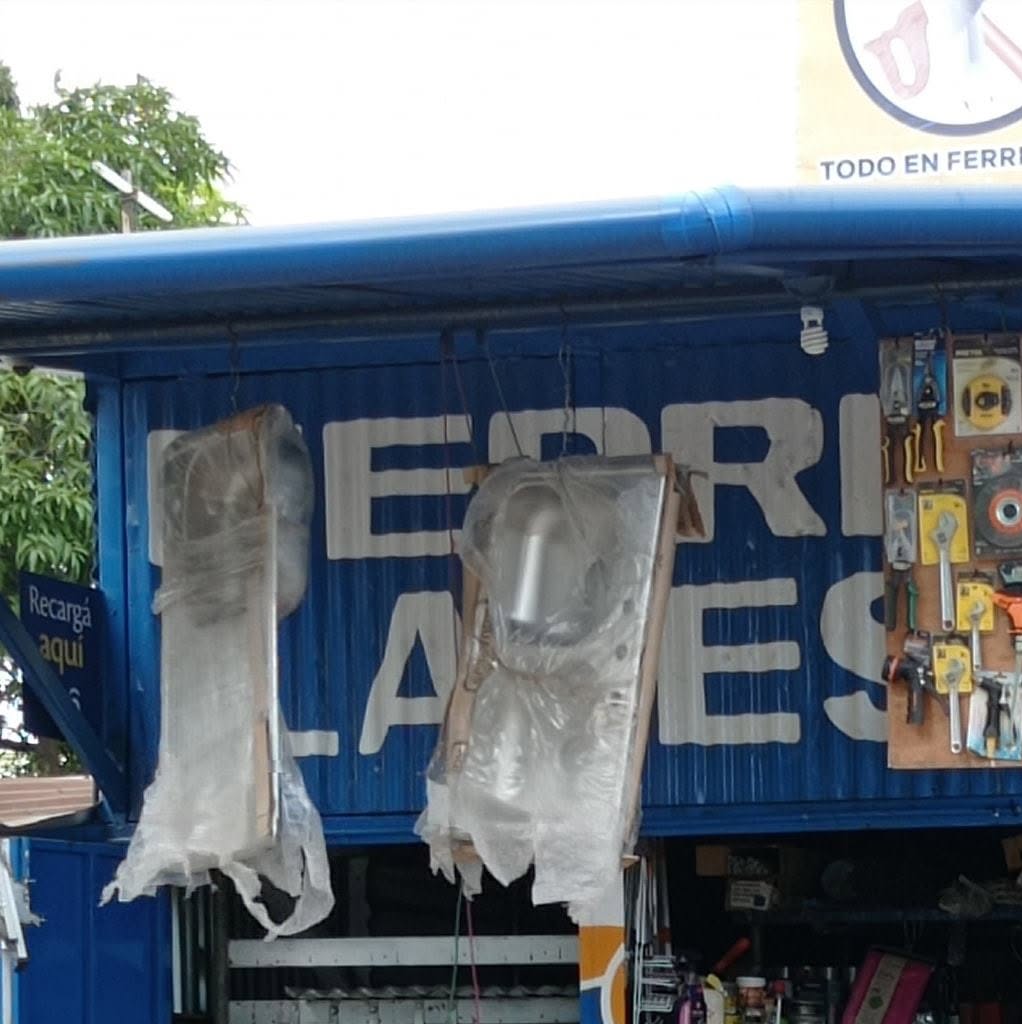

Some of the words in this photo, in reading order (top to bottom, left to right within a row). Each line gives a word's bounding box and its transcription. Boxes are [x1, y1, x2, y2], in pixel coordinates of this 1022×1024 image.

[821, 157, 896, 181] TODO
[904, 153, 939, 174] EN
[29, 586, 91, 633] Recargá
[39, 634, 84, 675] aquí
